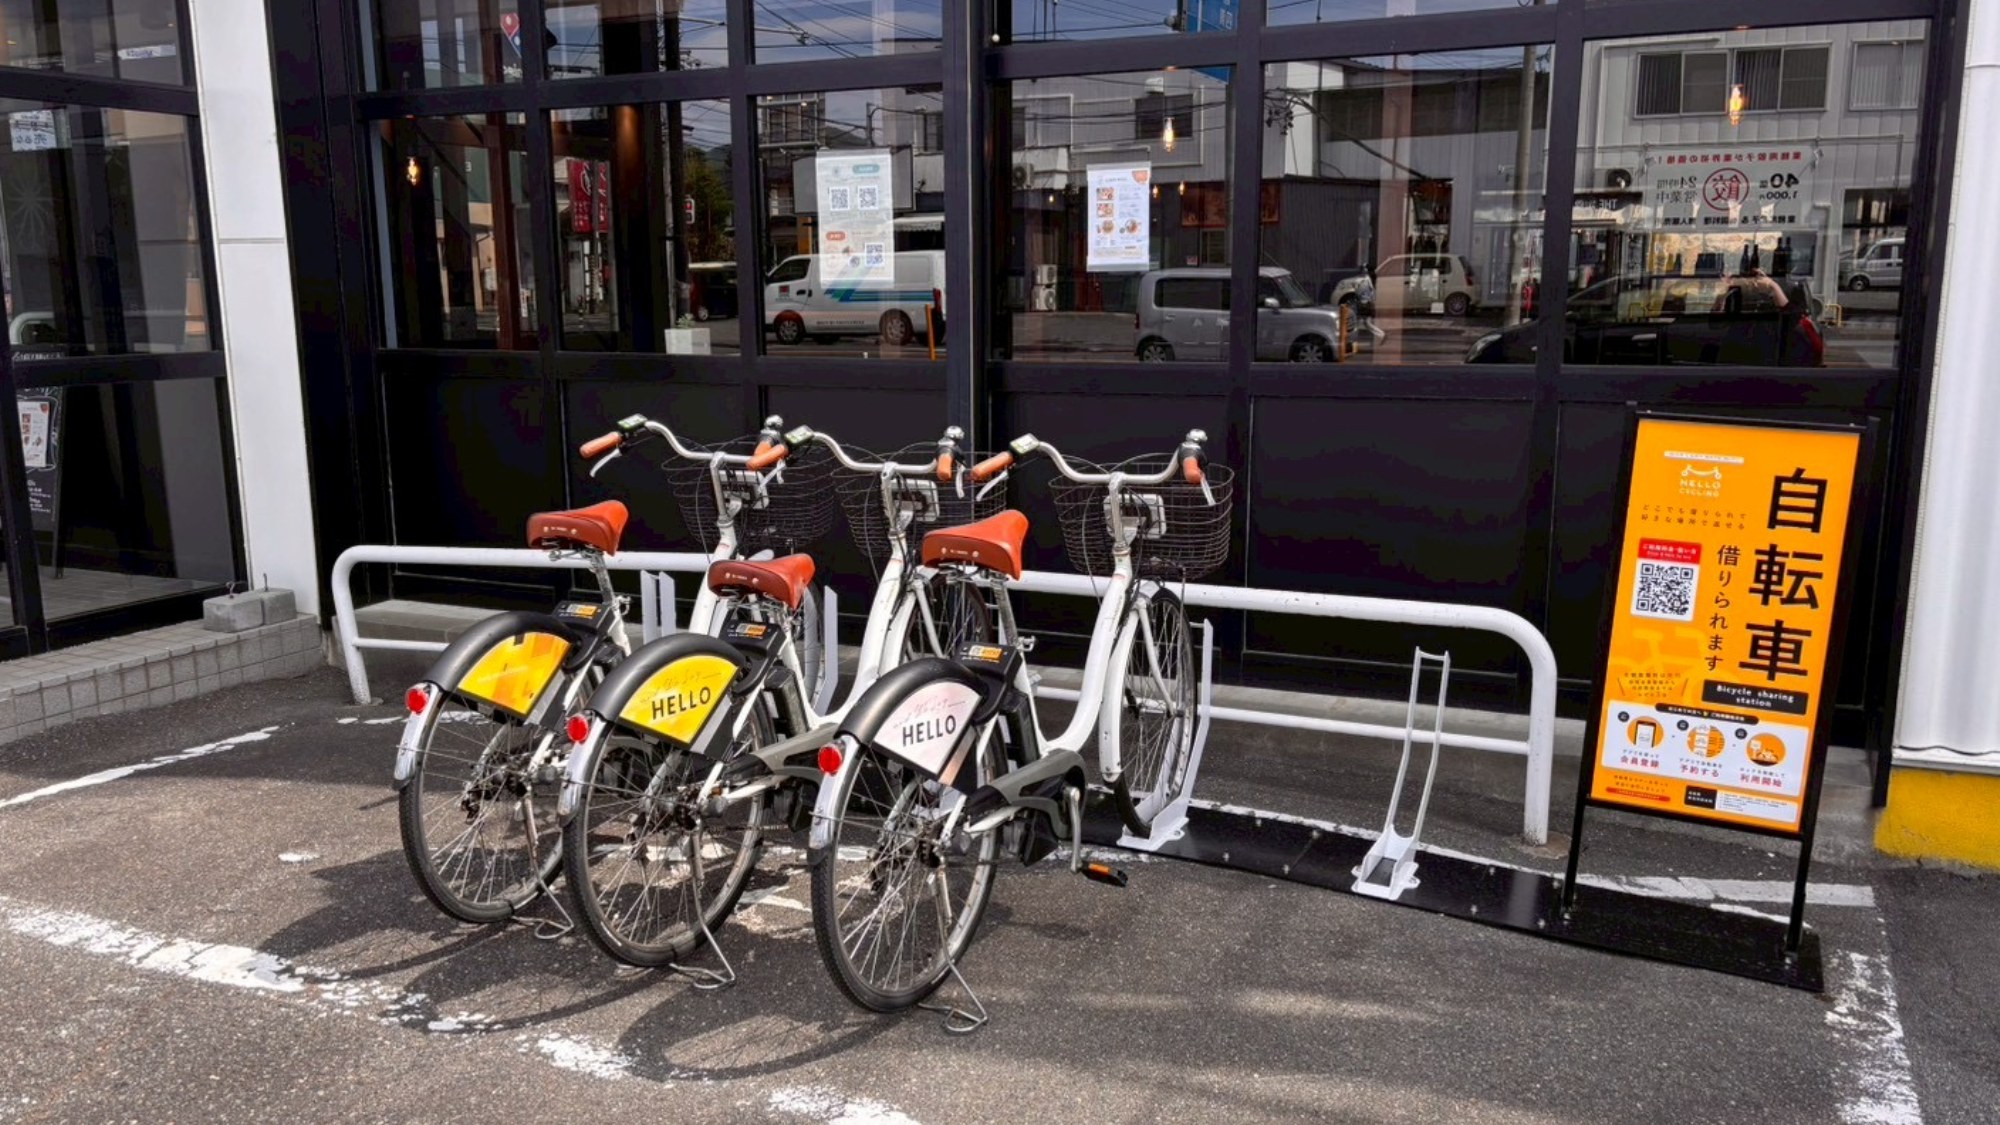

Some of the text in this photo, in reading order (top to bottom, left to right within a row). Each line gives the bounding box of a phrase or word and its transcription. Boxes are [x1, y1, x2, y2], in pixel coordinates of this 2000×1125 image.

[1738, 467, 1828, 681] 自転車
[1704, 544, 1741, 671] 借りられます
[652, 686, 711, 720] HELLO
[1716, 684, 1795, 704] Bicycle sharing
[1736, 697, 1772, 708] station
[902, 714, 957, 747] HELLO
[1680, 764, 1719, 778] 予約する
